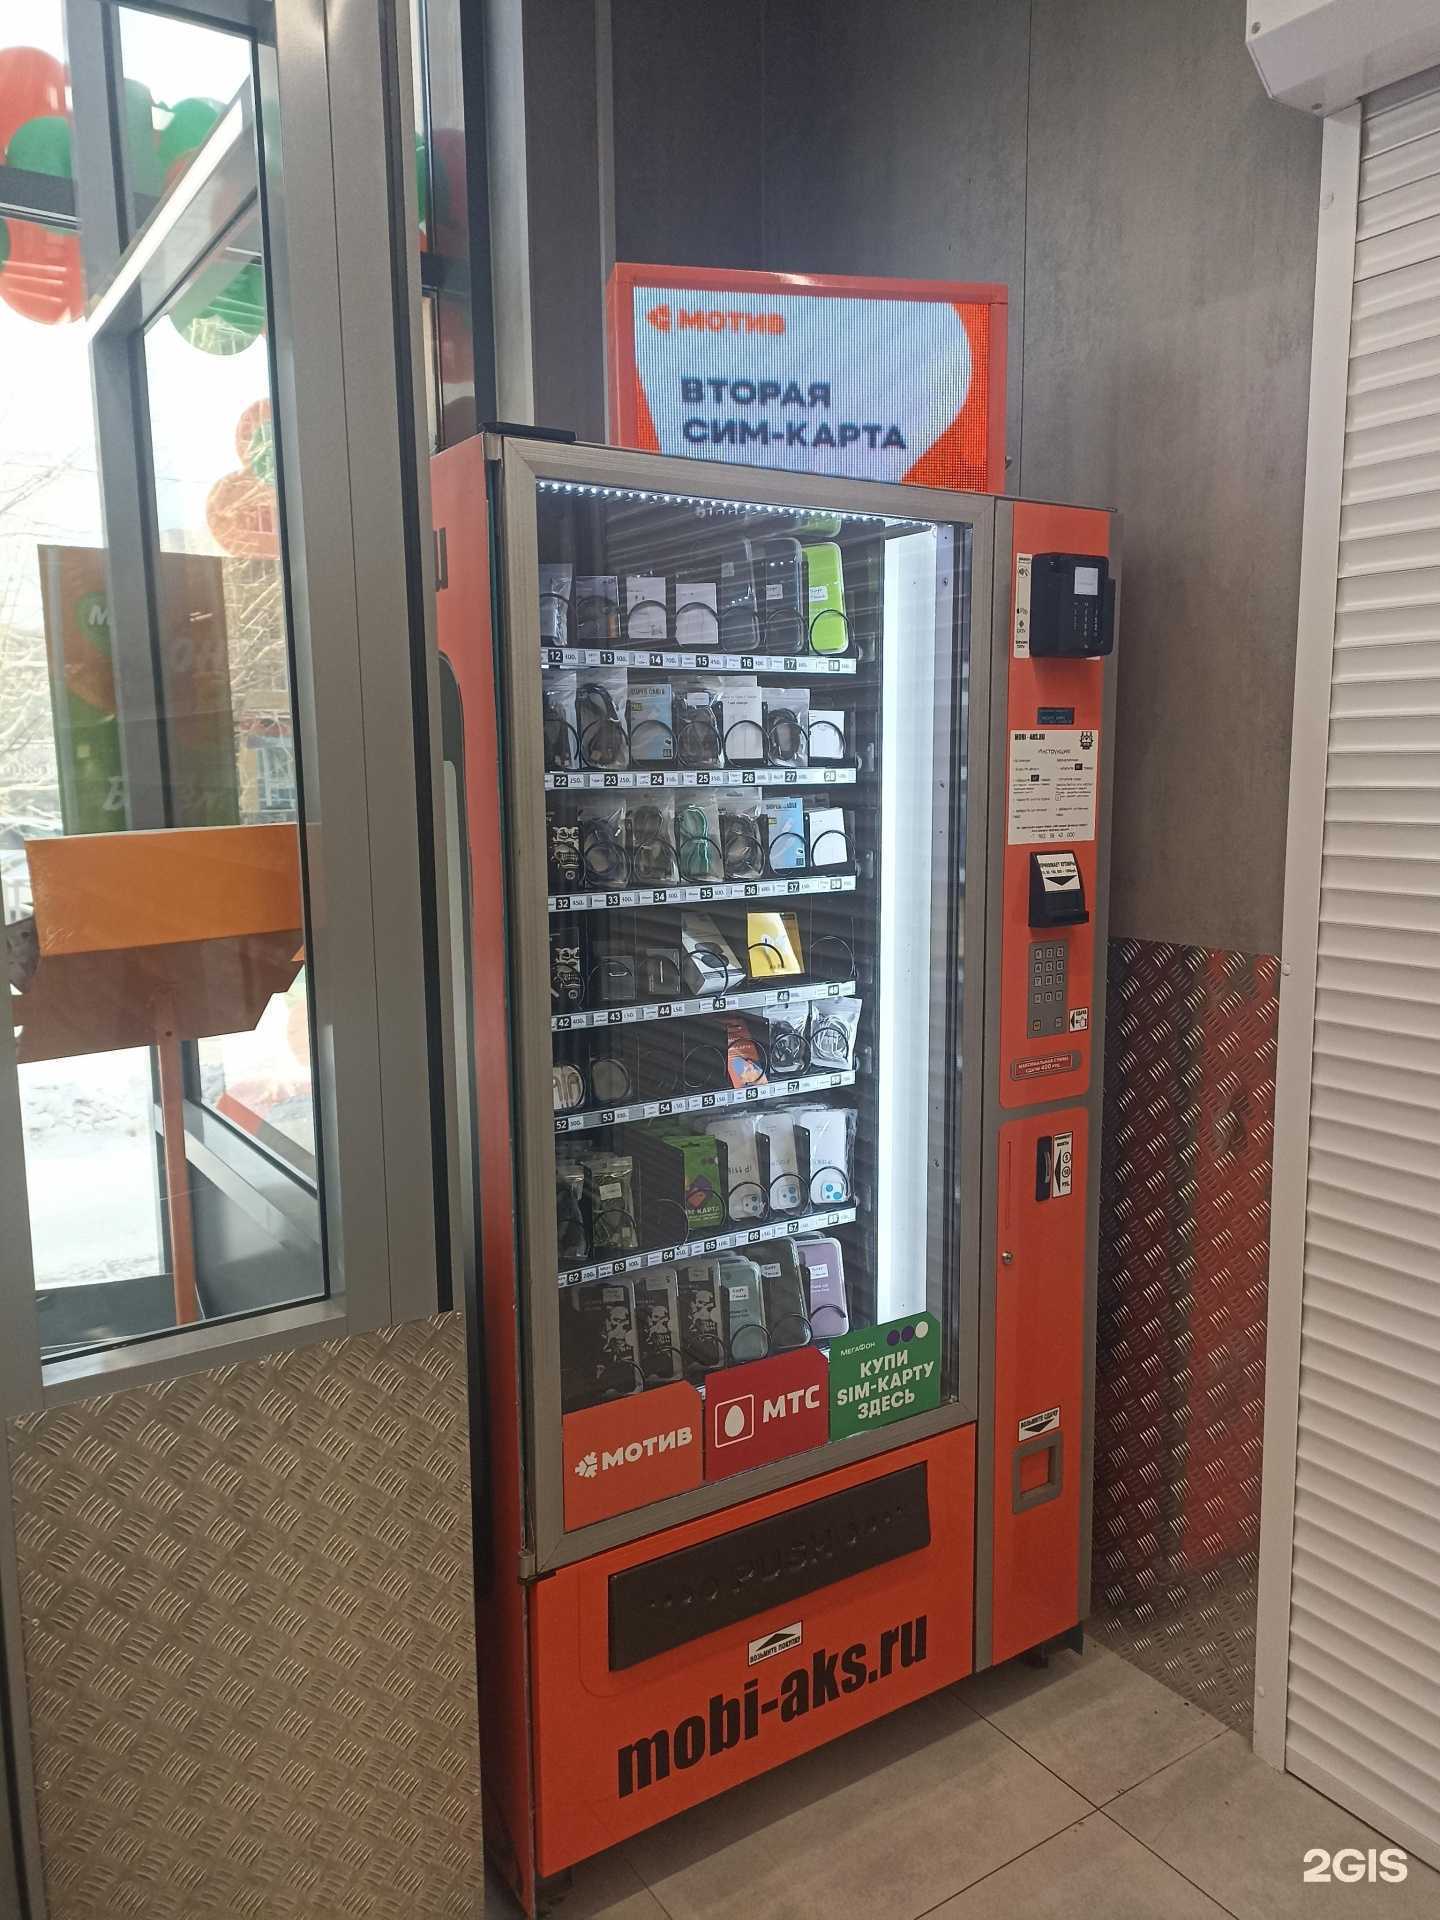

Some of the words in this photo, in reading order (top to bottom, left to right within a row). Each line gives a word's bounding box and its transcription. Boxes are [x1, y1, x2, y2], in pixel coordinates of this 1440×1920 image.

[678, 307, 787, 336] МОТИВ
[680, 375, 832, 408] ВТОРАЯ
[681, 418, 907, 451] СИМ-КАРТА
[549, 650, 562, 661] 12
[601, 651, 613, 663] 13
[650, 654, 662, 665] 14
[696, 656, 708, 667] 15
[741, 658, 752, 668] 16
[785, 659, 796, 670] 17
[554, 776, 568, 786] 22
[605, 775, 617, 786] 23
[652, 774, 663, 785] 24
[697, 773, 709, 784] 25
[743, 772, 754, 783] 26
[786, 771, 796, 782] 27
[557, 898, 569, 909] 32
[607, 894, 619, 906] 33
[653, 891, 665, 901] 34
[701, 888, 712, 899] 35
[745, 885, 757, 896] 36
[789, 882, 799, 892] 37
[557, 1017, 570, 1028] 42
[608, 1012, 621, 1022] 43
[659, 1006, 671, 1015] 44
[713, 998, 725, 1009] 45
[555, 1120, 567, 1130] 52
[602, 1112, 614, 1122] 53
[660, 1103, 671, 1113] 54
[703, 1095, 714, 1105] 55
[746, 1089, 758, 1099] 56
[788, 1082, 799, 1092] 57
[567, 1272, 580, 1283] 62
[613, 1262, 626, 1273] 63
[662, 1251, 674, 1261] 64
[704, 1241, 716, 1251] 65
[788, 1223, 799, 1233] 67
[860, 1349, 909, 1379] КУПИ
[837, 1360, 935, 1406] SIM-КАРТУ
[762, 1384, 821, 1424] МТС
[857, 1388, 915, 1420] ЗДЕСЬ
[601, 1426, 693, 1471] МОТИВ
[617, 1614, 928, 1799] mobi-aks.ru
